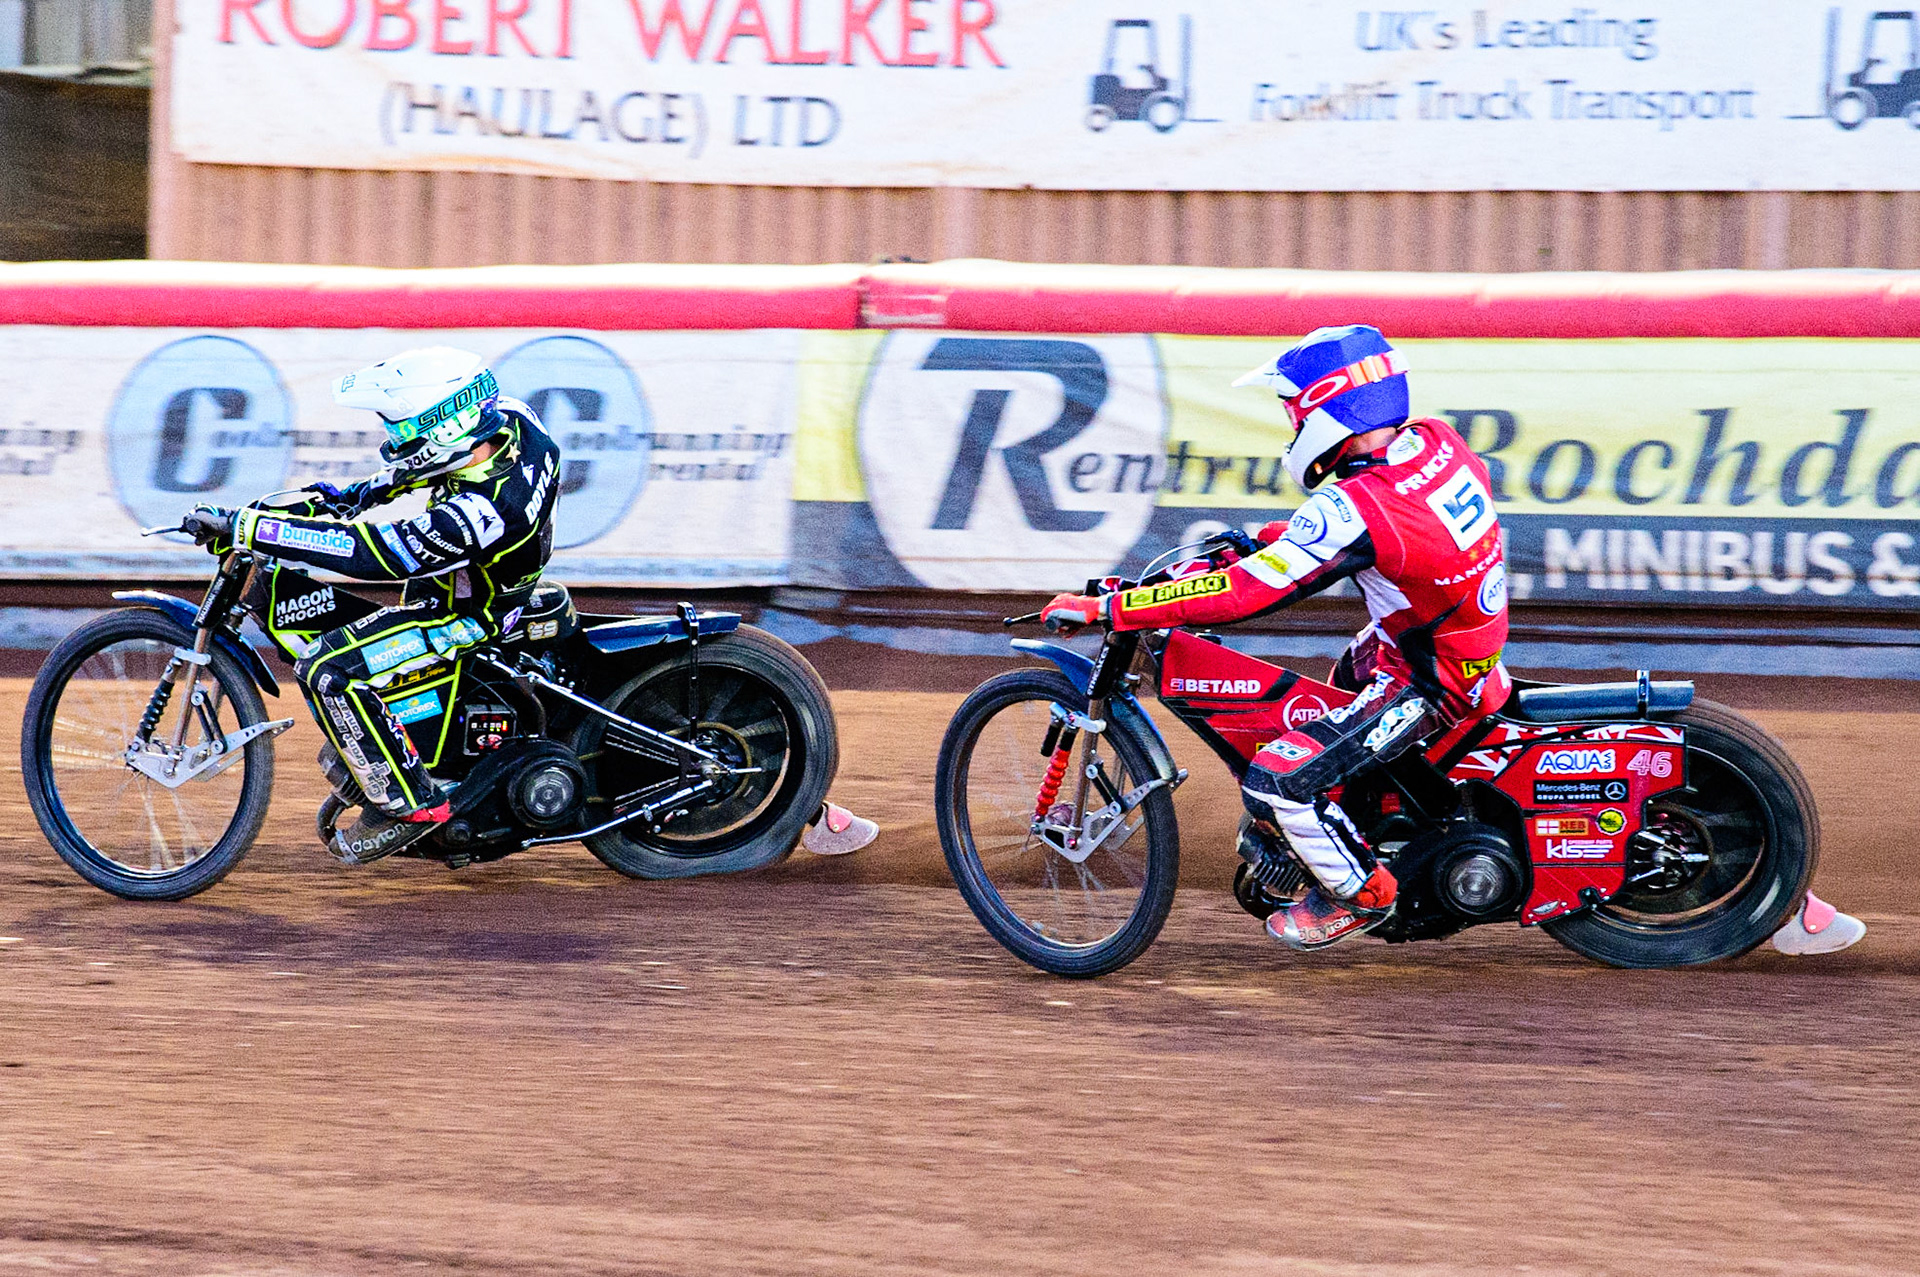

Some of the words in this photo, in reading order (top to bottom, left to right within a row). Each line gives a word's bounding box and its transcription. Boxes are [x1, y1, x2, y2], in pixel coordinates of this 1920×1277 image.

[214, 0, 576, 59] ROBERT
[627, 0, 1008, 68] WALKER
[1355, 9, 1460, 51] UK's
[1472, 8, 1658, 60] Leading
[379, 81, 709, 159] (HAULAGE)
[733, 95, 841, 148] LTD
[1250, 82, 1398, 121] Forklift
[1416, 79, 1532, 120] Truck
[1546, 79, 1756, 131] Transport
[917, 337, 1305, 533] Rentru
[1395, 441, 1454, 495] FRICKE
[524, 451, 554, 525] DOYLE
[1442, 481, 1486, 534] 5
[282, 524, 353, 550] burnside
[426, 529, 464, 555] Euston
[1544, 527, 1855, 597] MINIBUS
[1866, 530, 1920, 597] &
[276, 586, 335, 617] HAGON
[277, 600, 336, 627] SHOCKS
[369, 637, 422, 666] MOTOREX
[1185, 679, 1261, 694] BETARD
[1291, 708, 1321, 722] ATPI
[1540, 753, 1604, 770] AQUA
[1626, 750, 1673, 778] 46
[1536, 783, 1601, 792] Mercedes-Benz
